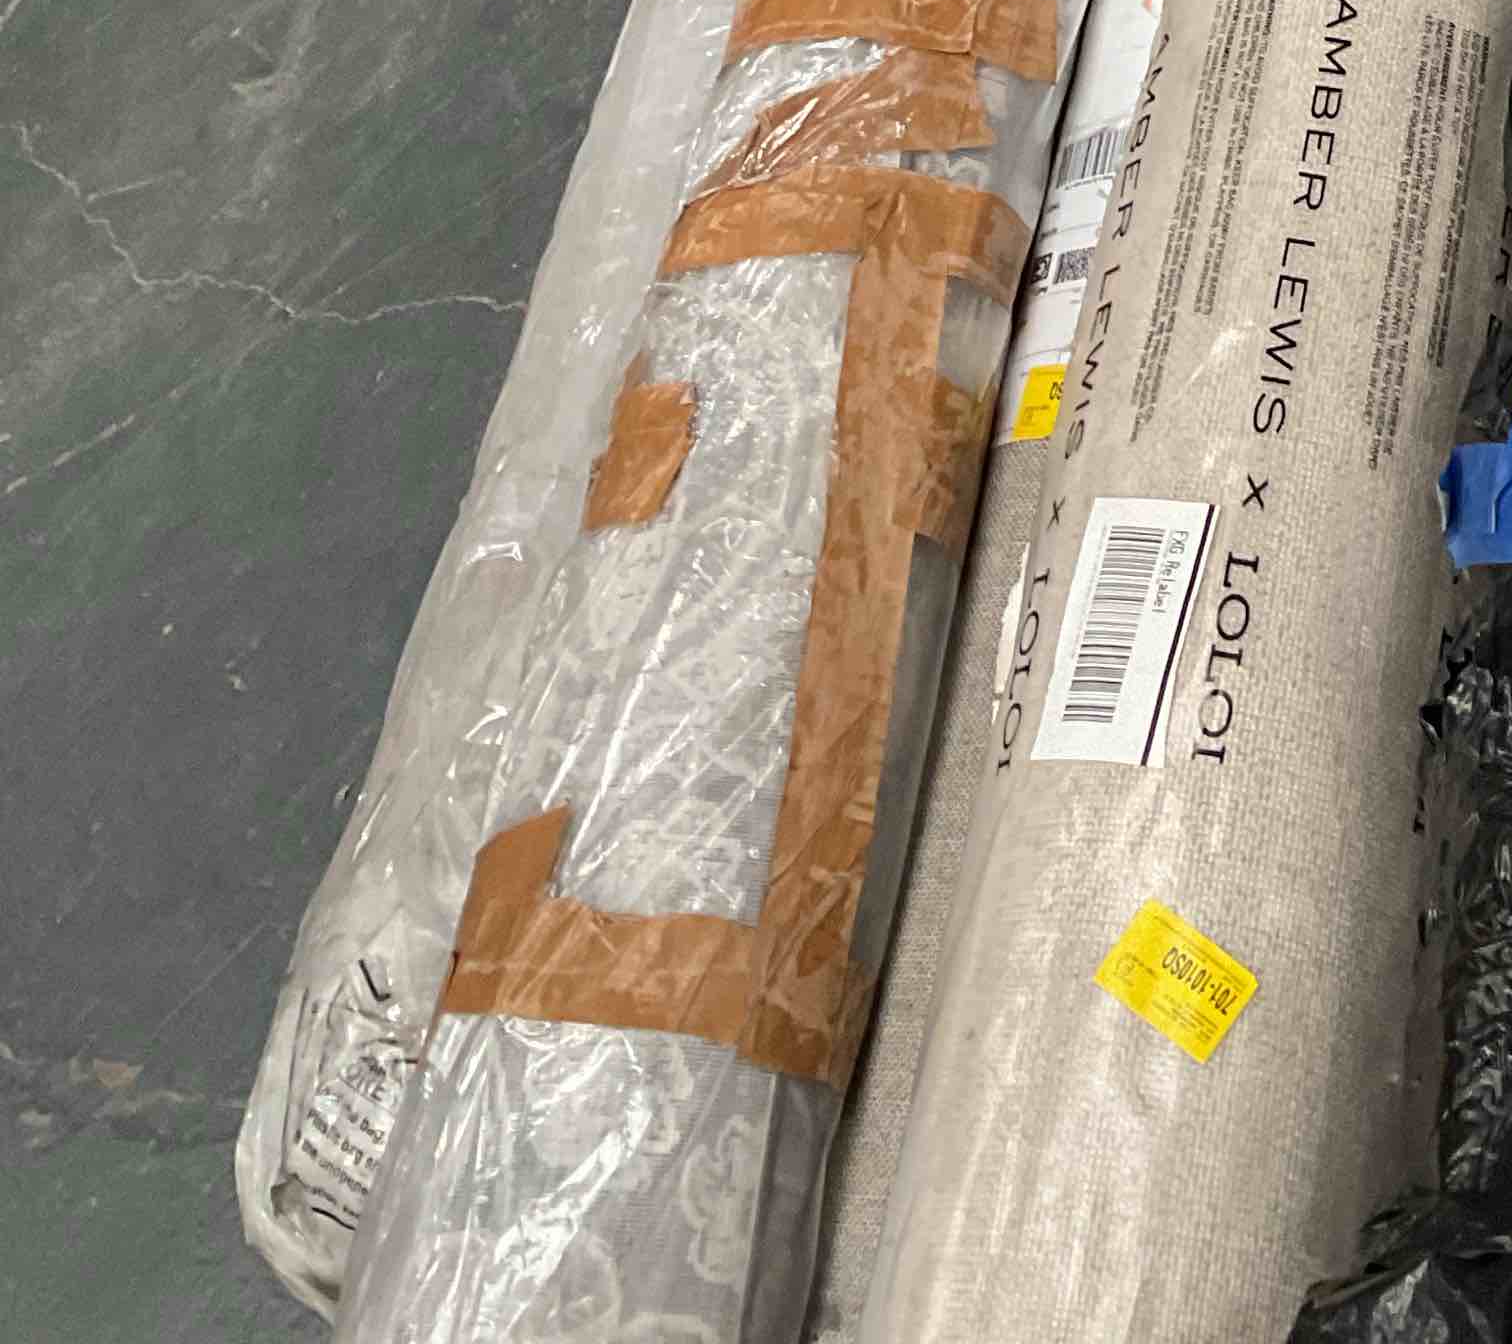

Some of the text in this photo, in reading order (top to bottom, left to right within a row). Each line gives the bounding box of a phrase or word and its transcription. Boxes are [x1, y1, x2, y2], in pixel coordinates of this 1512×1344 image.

[1113, 33, 1170, 240] AMBER
[1064, 264, 1120, 460] LEWIS
[1252, 237, 1316, 434] LEWIS
[1171, 529, 1190, 556] FXG
[996, 568, 1050, 776] LOLOI
[1192, 552, 1260, 764] LOLOI
